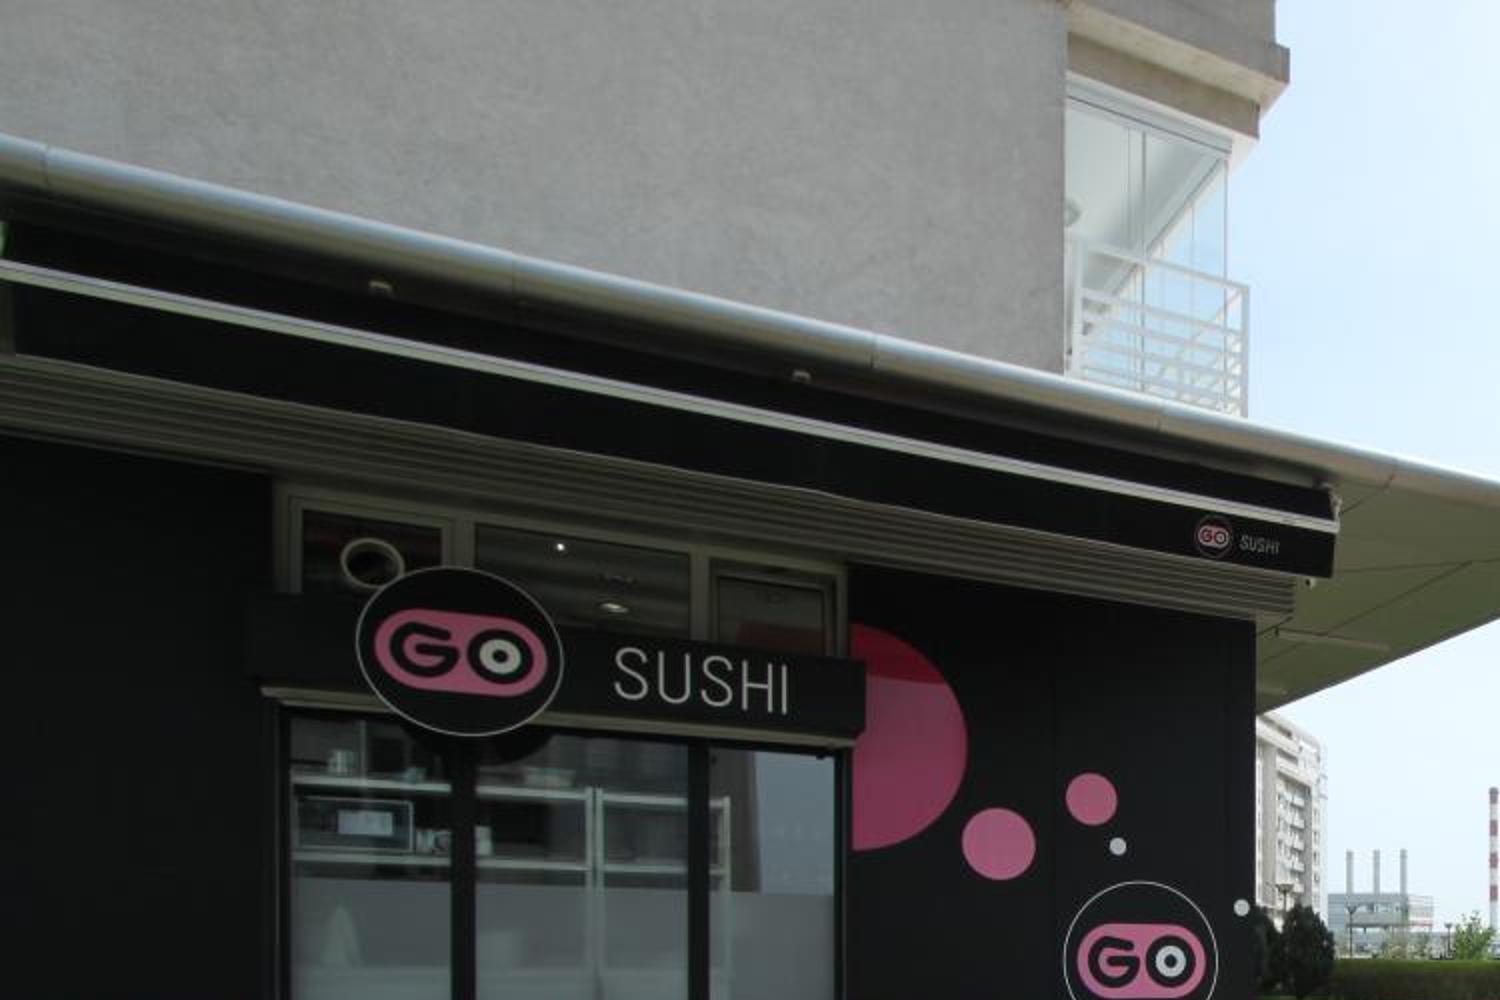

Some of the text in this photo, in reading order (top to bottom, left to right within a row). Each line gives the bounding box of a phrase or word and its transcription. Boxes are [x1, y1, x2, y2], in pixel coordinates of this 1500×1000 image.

[1202, 528, 1280, 554] GO SUSHI
[388, 620, 789, 715] GO SUSHI
[1087, 934, 1198, 989] GO
